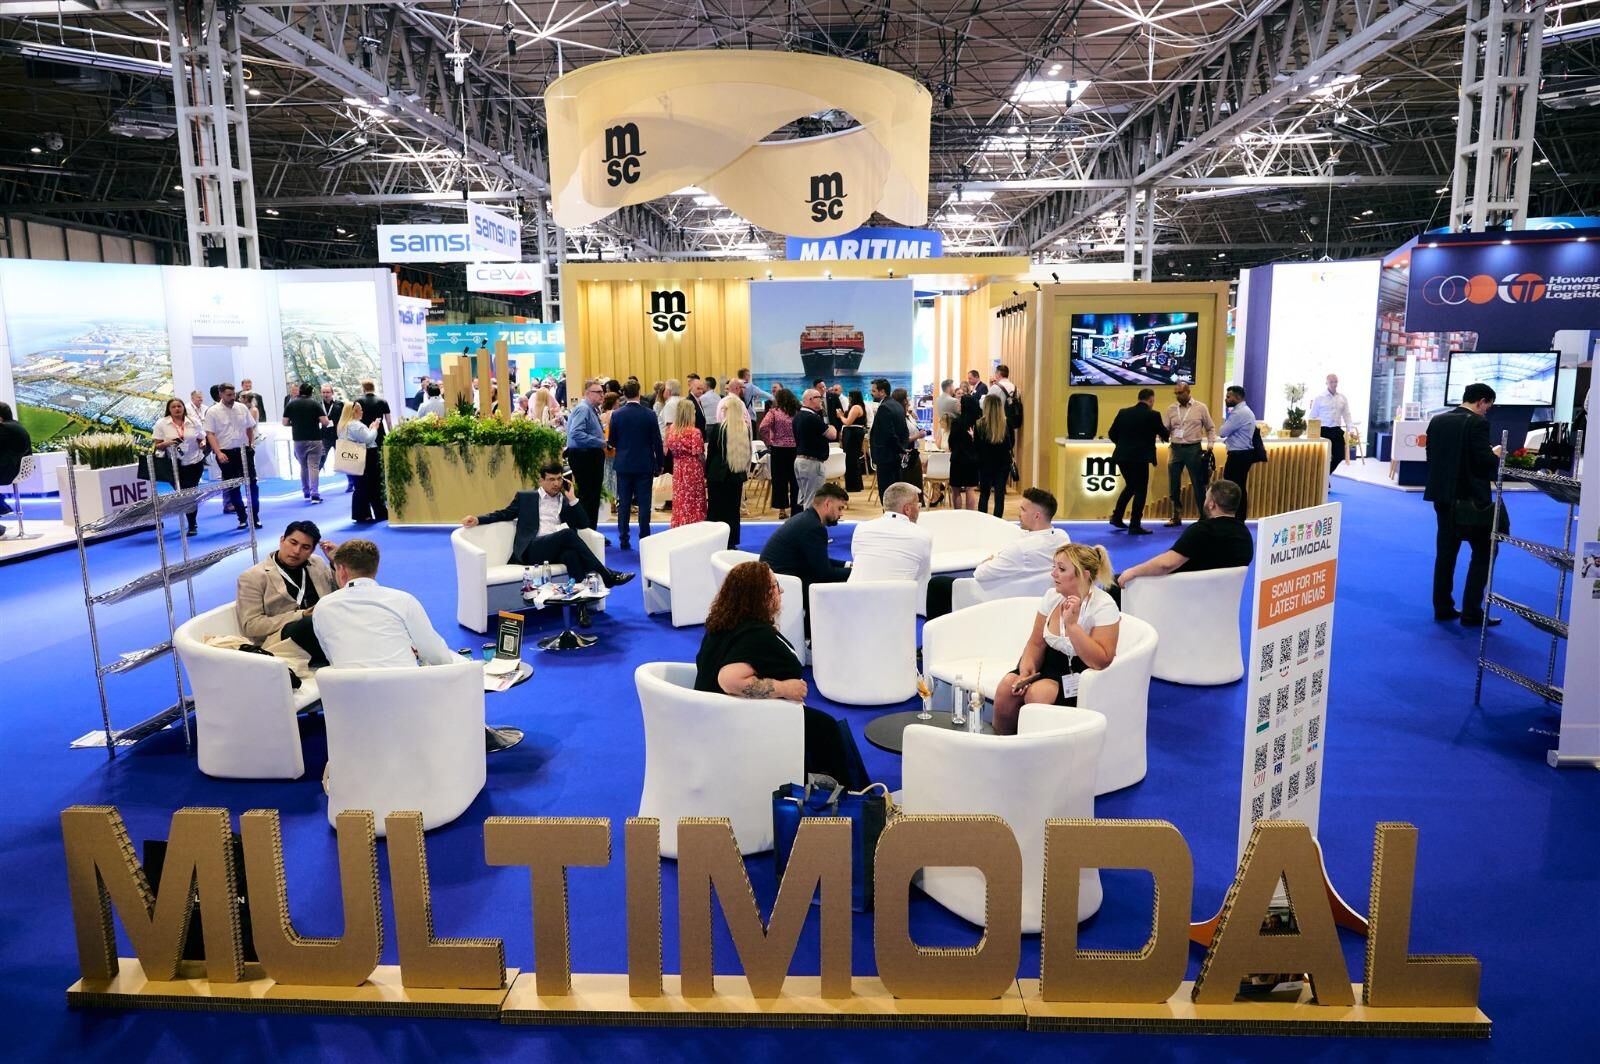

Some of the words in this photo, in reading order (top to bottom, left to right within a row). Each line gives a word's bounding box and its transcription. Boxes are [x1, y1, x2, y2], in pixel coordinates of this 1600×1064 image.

[800, 239, 932, 261] MARITIME
[1545, 283, 1600, 291] Tenens
[341, 451, 359, 460] CNS
[110, 481, 148, 507] ONE
[1270, 539, 1331, 565] MULTIMODAL
[1271, 579, 1295, 599] SCAN
[1295, 574, 1311, 592] FOR
[1311, 569, 1327, 585] THE
[1269, 594, 1301, 618] LATEST
[1301, 585, 1326, 607] NEWS
[61, 805, 1481, 1007] MULTIMODAL
